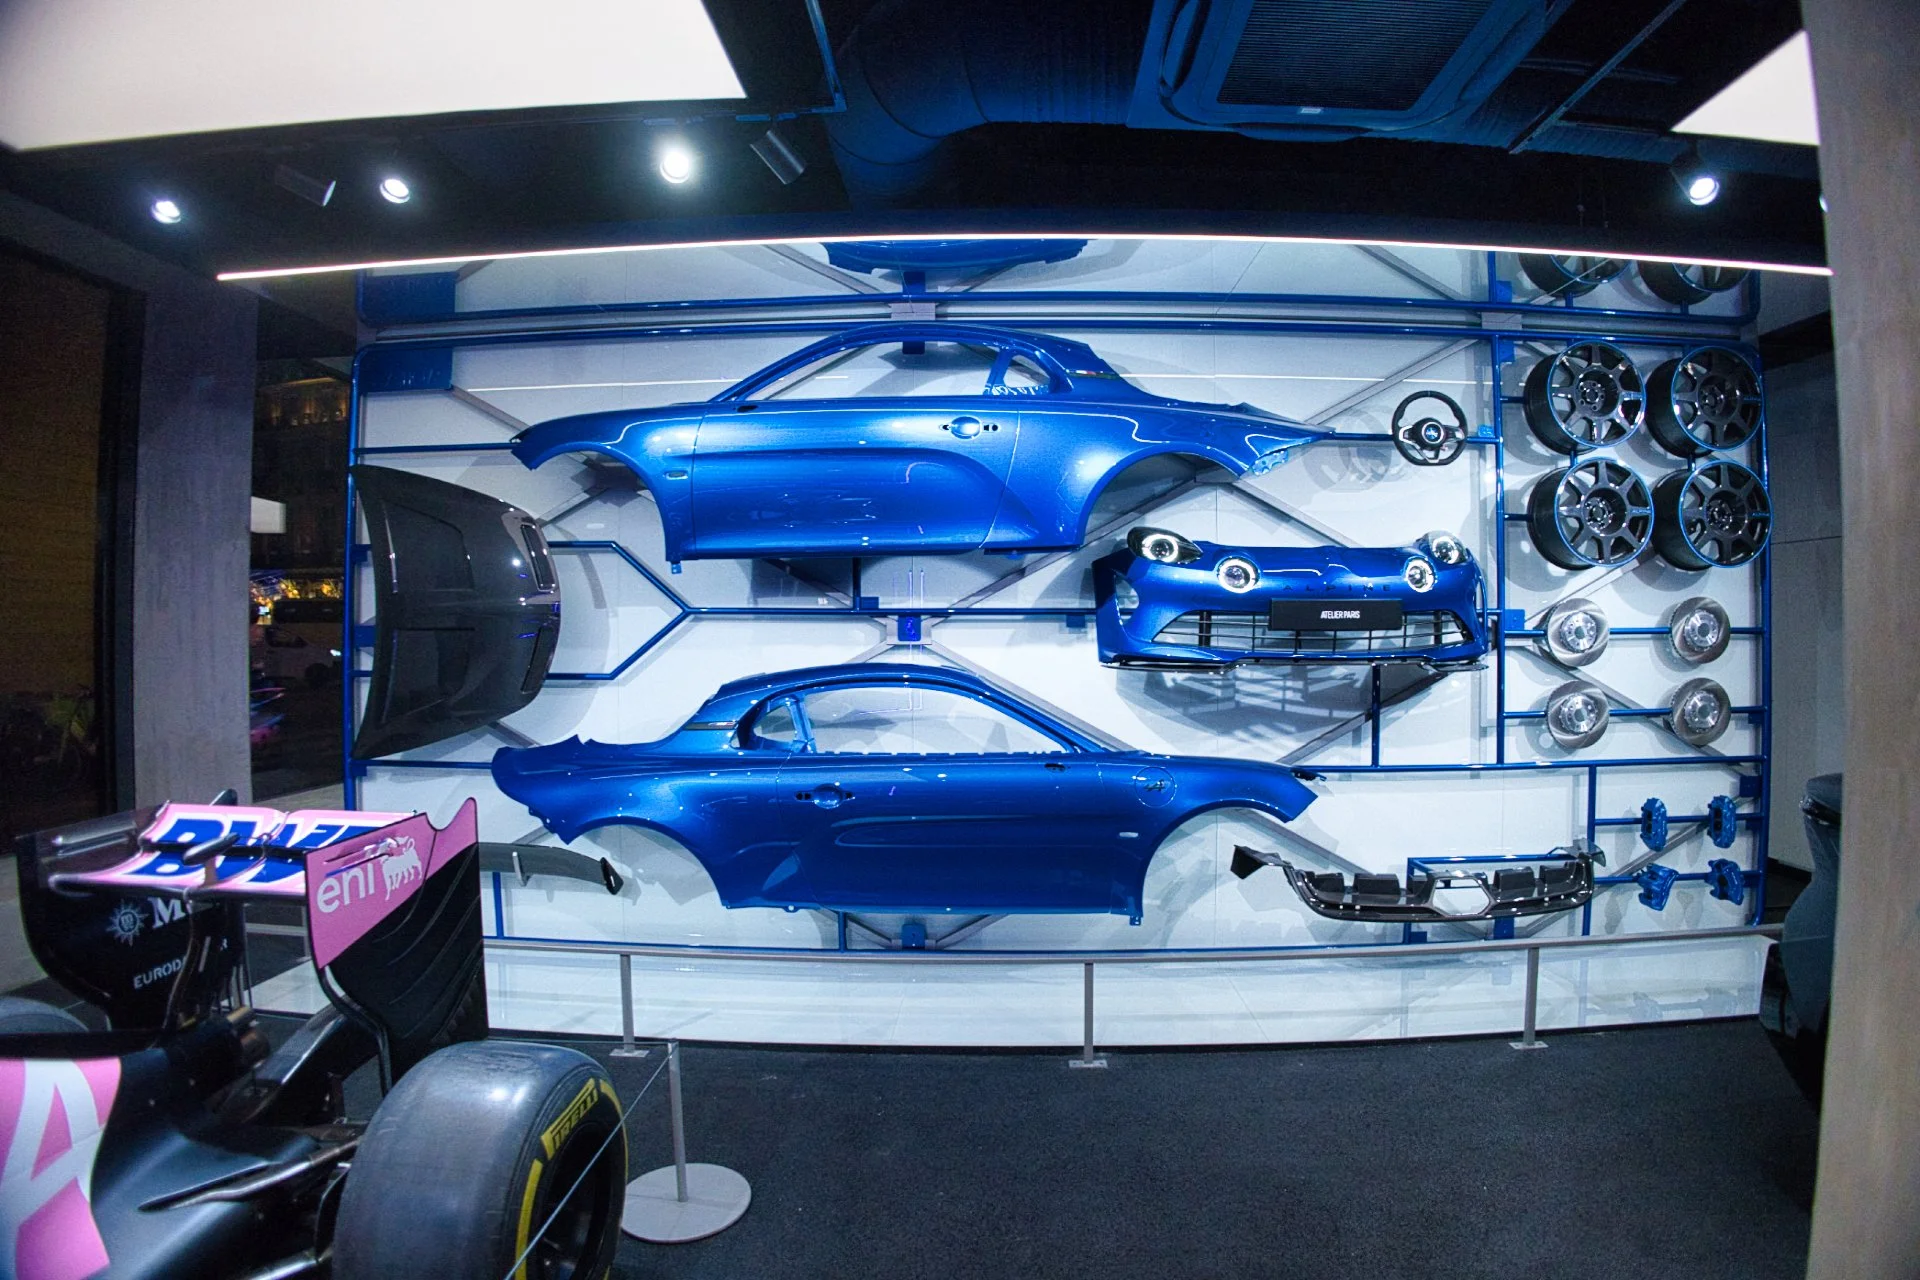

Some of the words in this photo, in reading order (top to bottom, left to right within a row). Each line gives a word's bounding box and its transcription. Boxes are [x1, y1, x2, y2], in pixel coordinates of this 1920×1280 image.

[1283, 584, 1391, 592] ALPINE
[1320, 610, 1343, 619] ATELIER
[1343, 610, 1361, 619] PARIS
[316, 851, 375, 913] eni
[541, 1077, 599, 1160] PIRELLI
